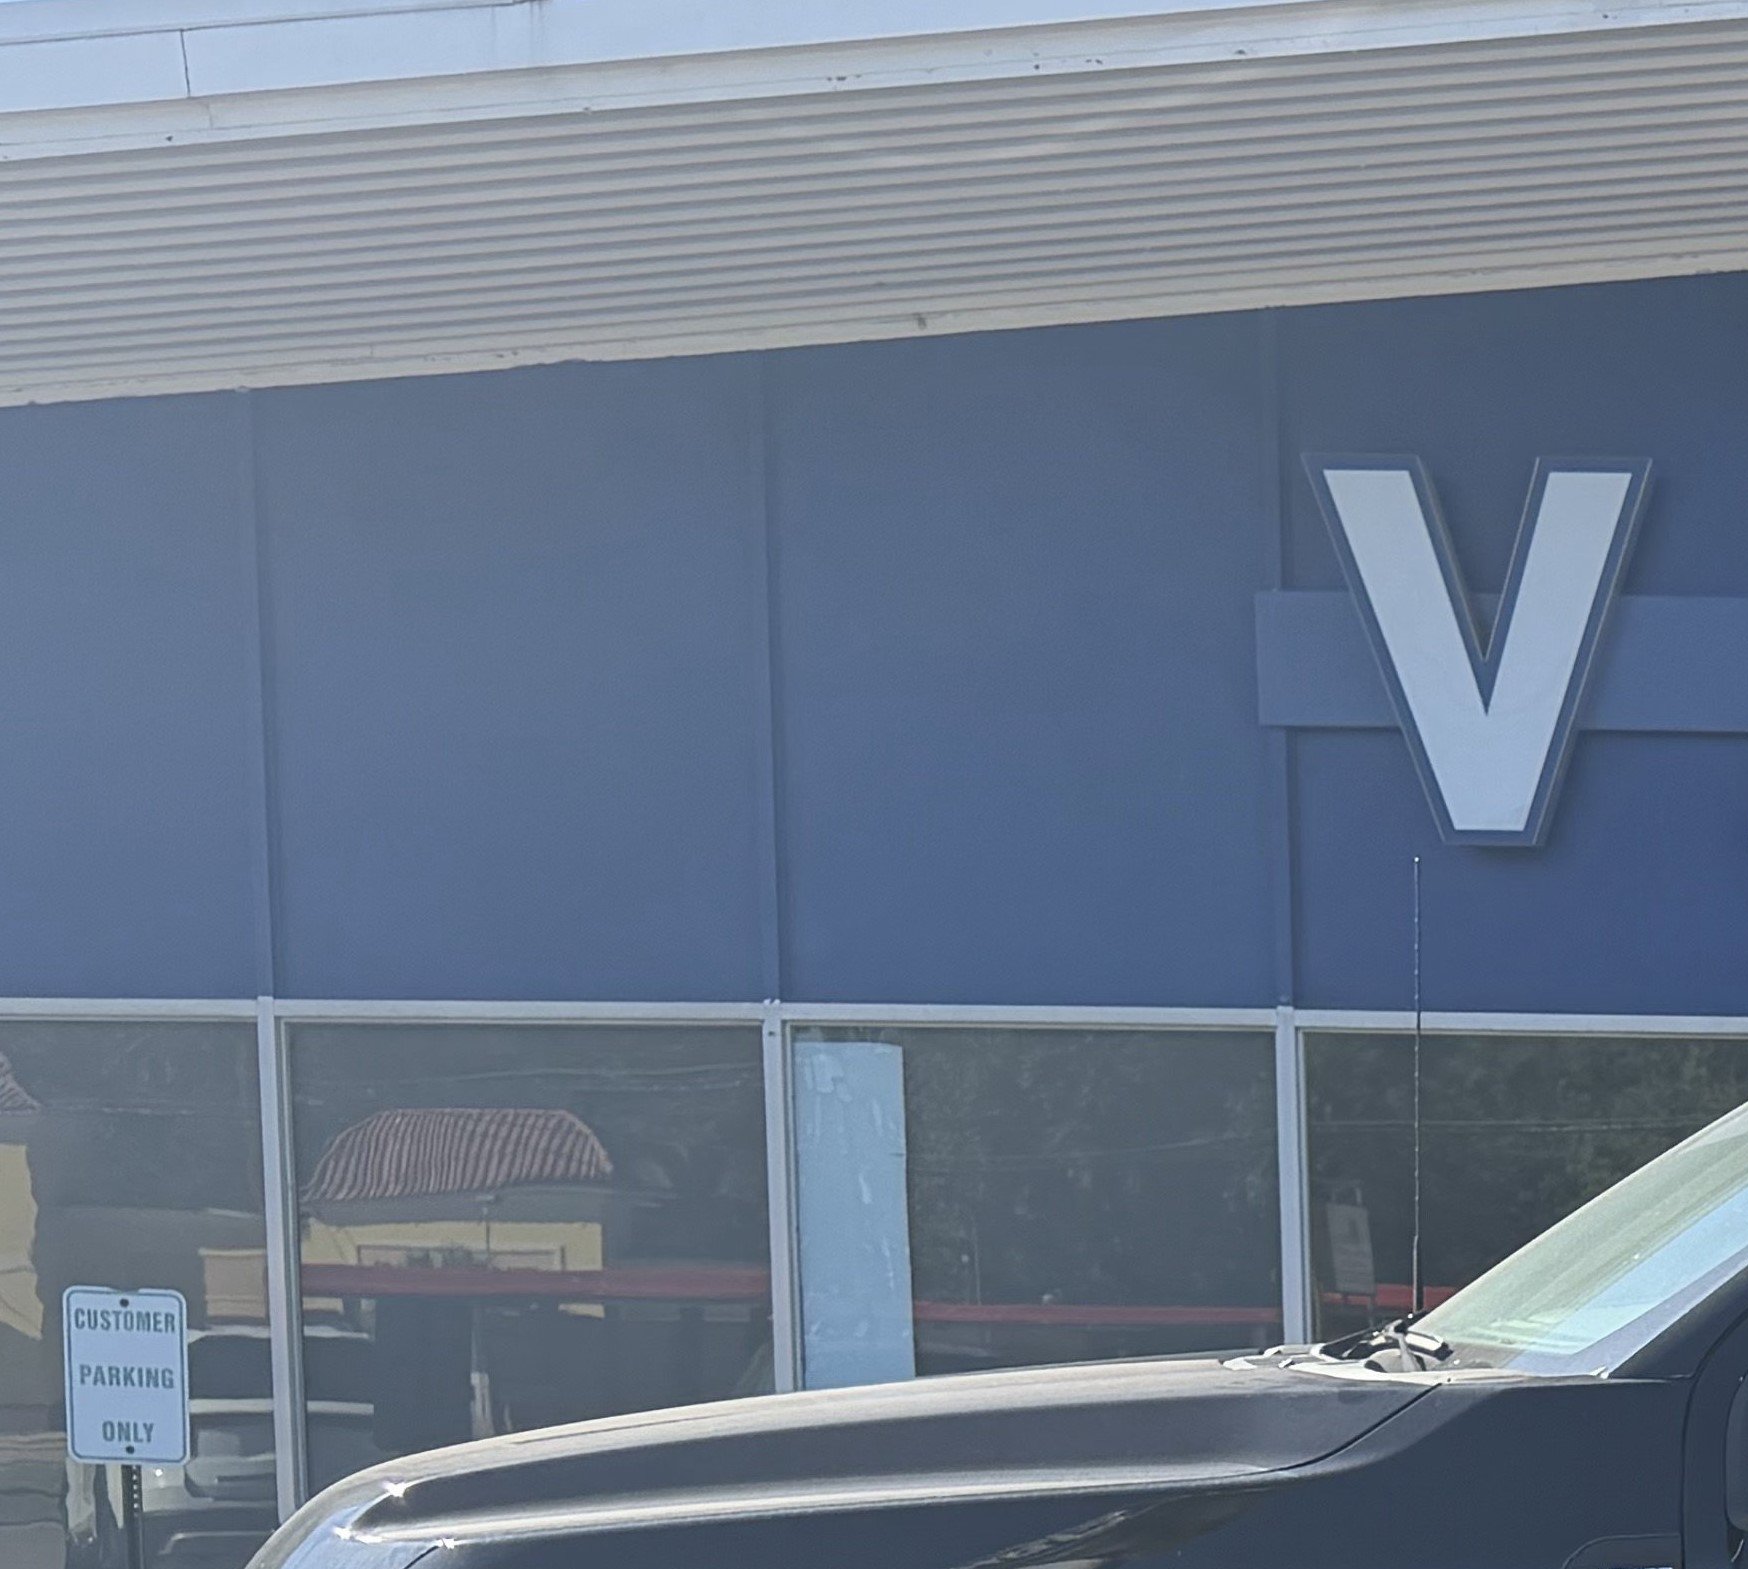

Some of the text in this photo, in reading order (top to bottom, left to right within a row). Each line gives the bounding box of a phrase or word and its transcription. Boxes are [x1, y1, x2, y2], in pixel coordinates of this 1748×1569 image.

[73, 1307, 176, 1334] CUSTOMER
[79, 1363, 175, 1390] PARKING
[101, 1420, 155, 1444] ONLY
